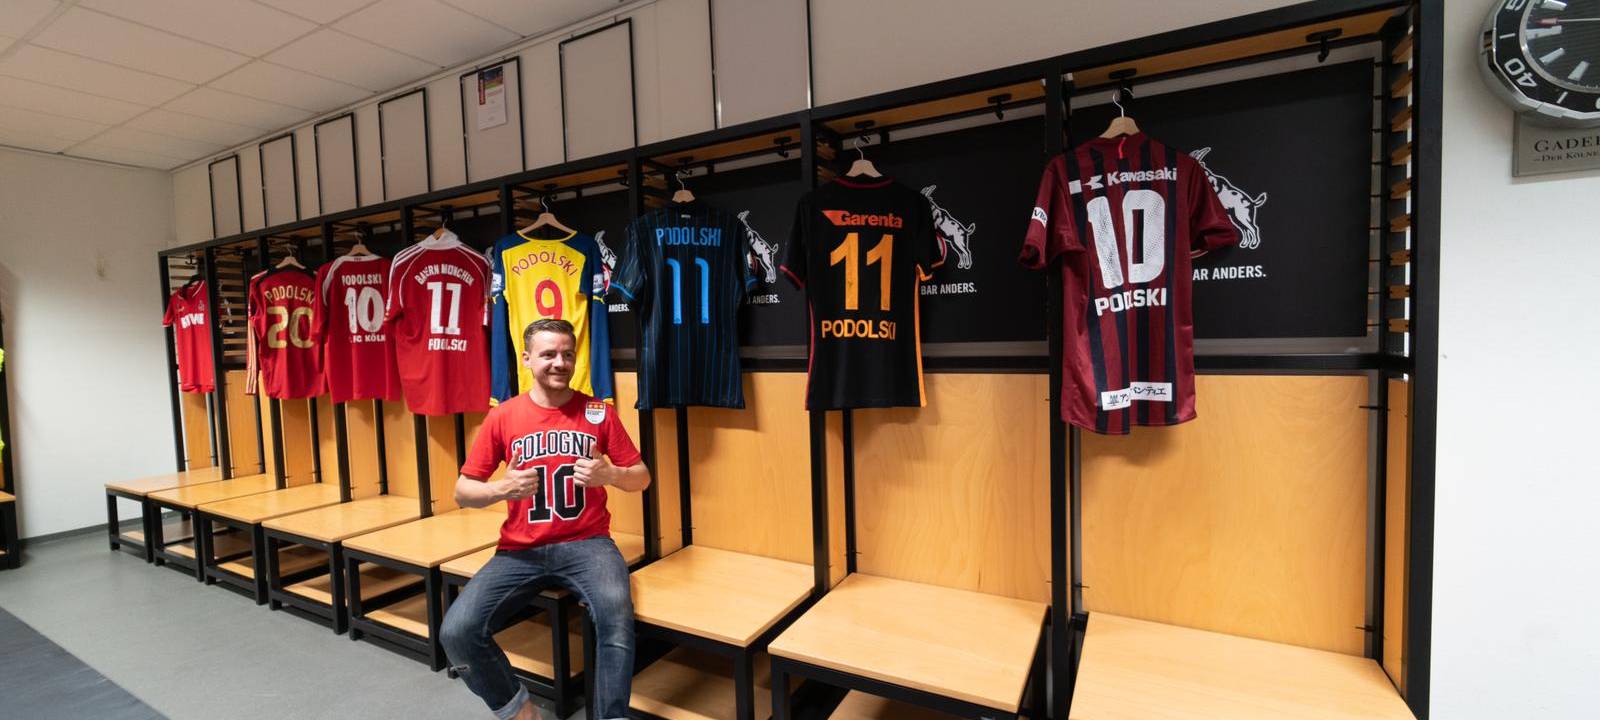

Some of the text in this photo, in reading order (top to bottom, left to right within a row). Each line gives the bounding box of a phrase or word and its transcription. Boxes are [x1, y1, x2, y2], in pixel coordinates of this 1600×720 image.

[1107, 167, 1177, 186] Kawasaki
[840, 210, 902, 228] Garenta
[655, 227, 721, 247] PODOLSKI
[1087, 189, 1165, 289] 10
[414, 264, 440, 285] BAYERN
[512, 251, 578, 276] PODOLSKI
[829, 232, 893, 311] 11
[1212, 265, 1267, 280] ANDERS.
[535, 279, 562, 320] 9
[664, 257, 709, 324] 11
[940, 282, 977, 294] ANDERS.
[1094, 287, 1167, 316] PODLSKI
[344, 286, 384, 334] 10
[427, 282, 461, 335] 11
[267, 305, 314, 348] 20
[512, 430, 597, 465] COLOGNE
[528, 463, 586, 523] 10
